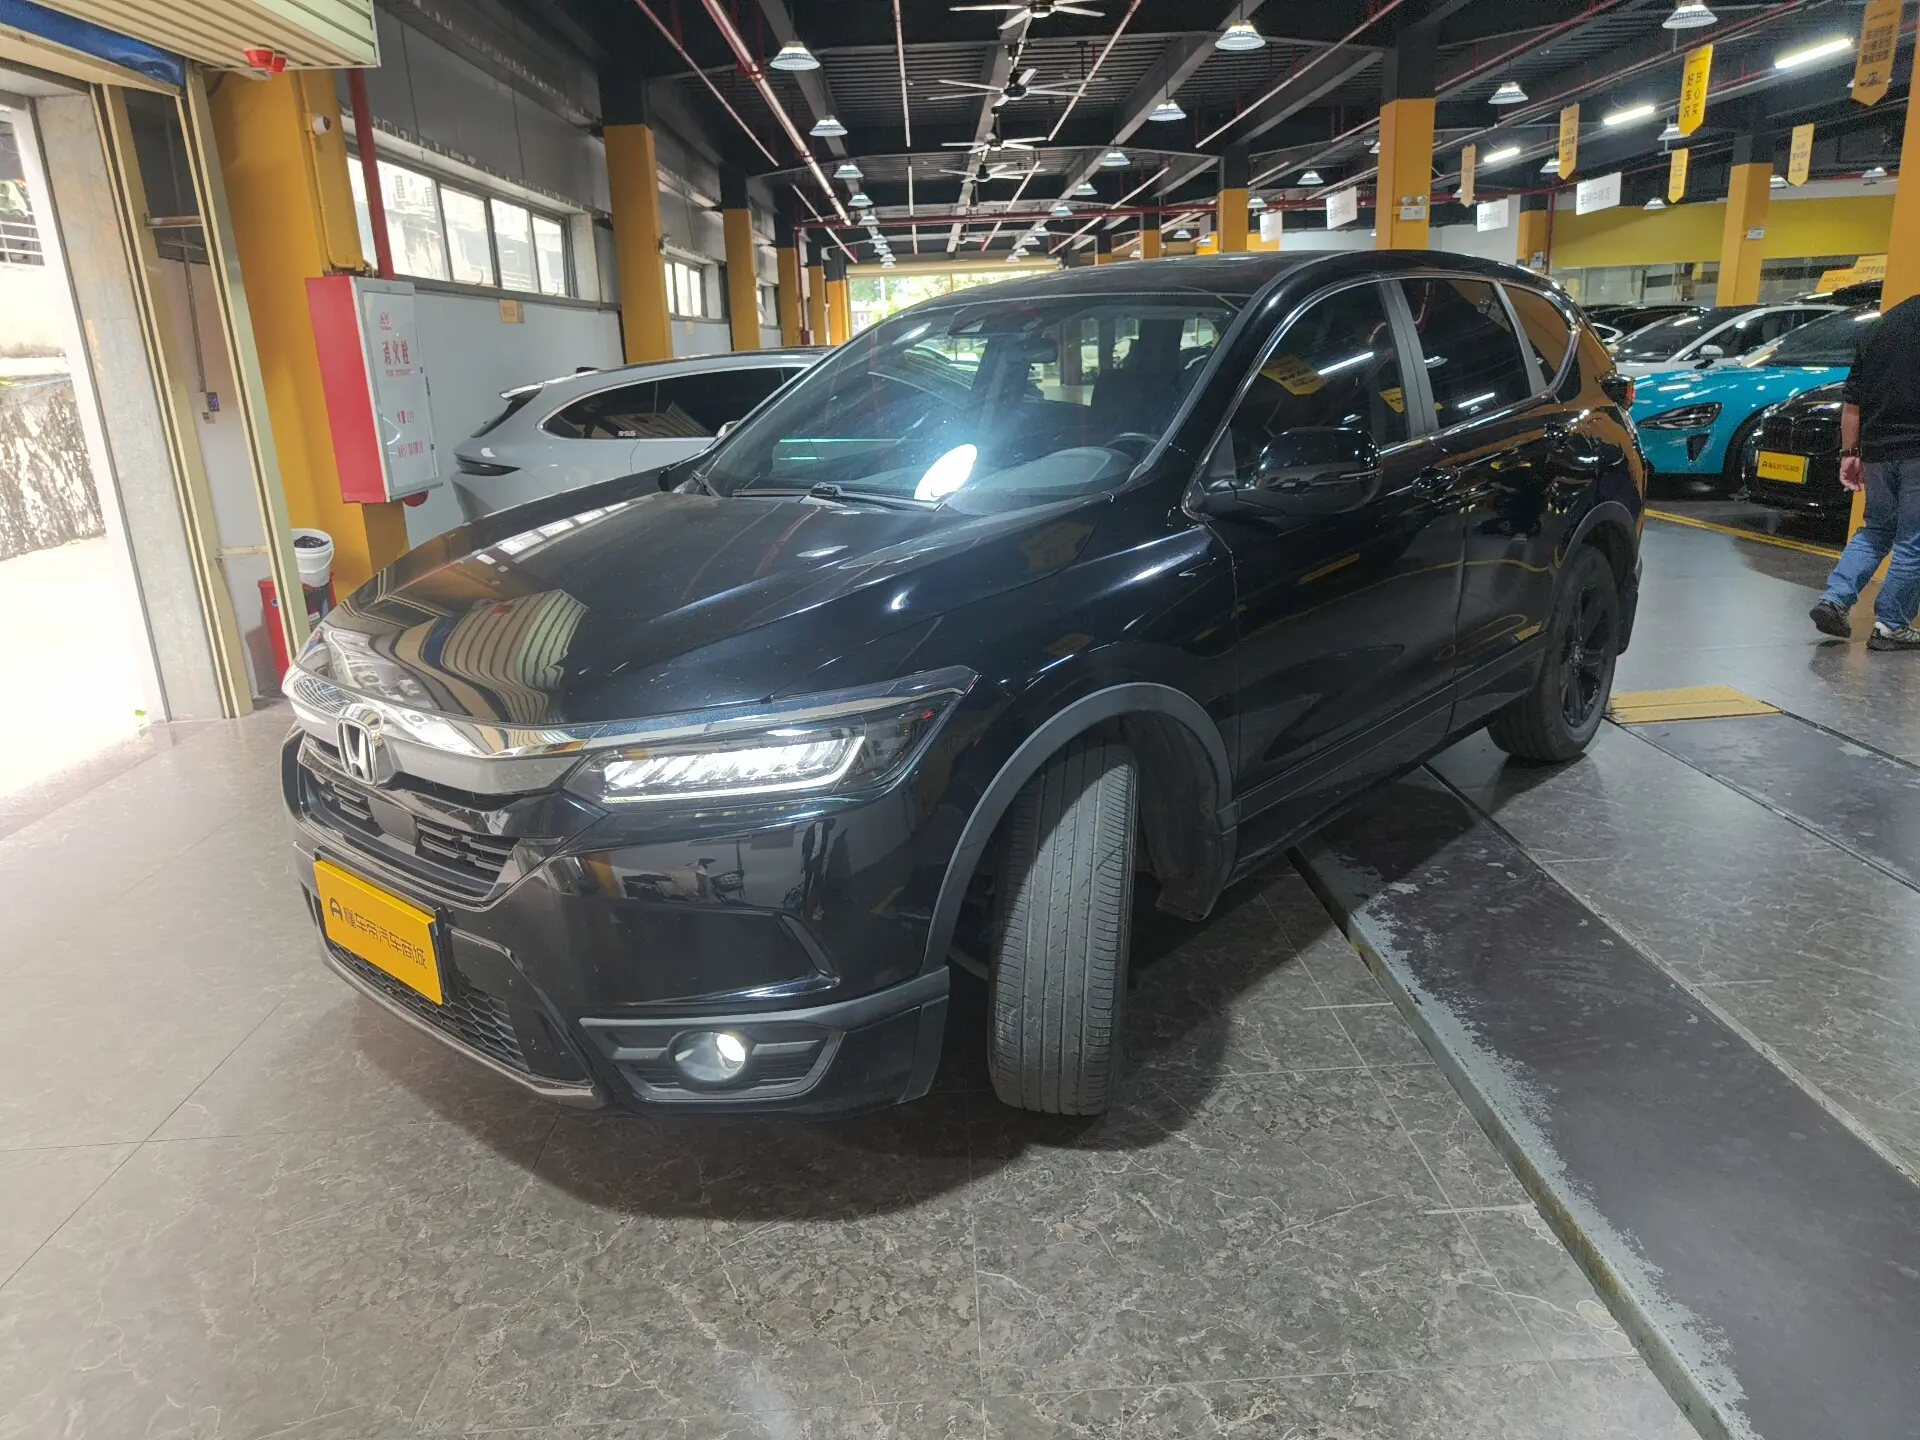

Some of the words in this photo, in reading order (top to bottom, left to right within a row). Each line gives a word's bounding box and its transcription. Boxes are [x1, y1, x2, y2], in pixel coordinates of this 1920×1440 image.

[382, 340, 410, 365] 消火栓
[343, 905, 429, 970] 懂车帝汽车商城
